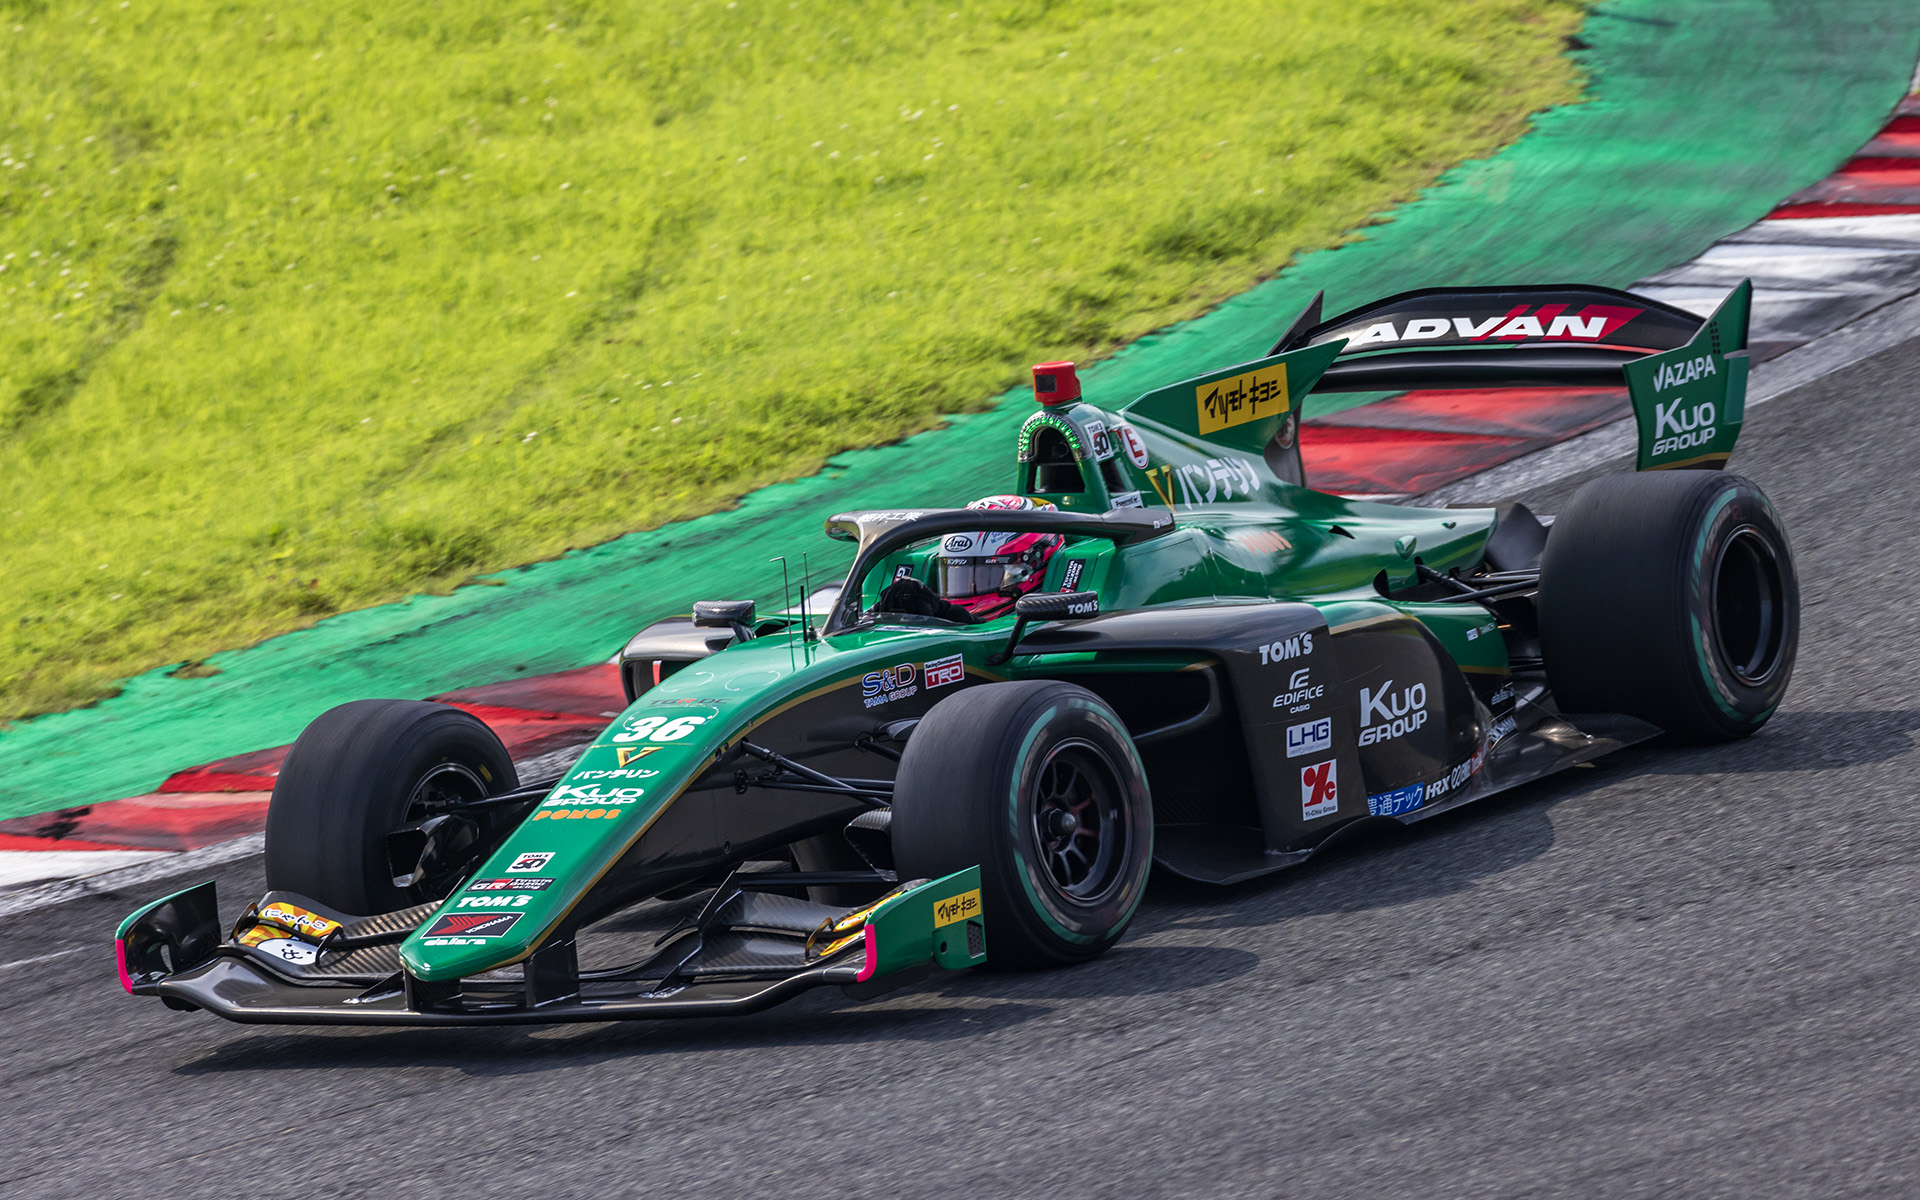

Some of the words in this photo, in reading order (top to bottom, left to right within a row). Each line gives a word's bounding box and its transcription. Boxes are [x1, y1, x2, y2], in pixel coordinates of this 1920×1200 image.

[1351, 315, 1608, 347] ADVAN
[1123, 428, 1144, 458] E
[1651, 427, 1716, 457] GROUP
[1176, 457, 1260, 510] バンテリン
[1068, 600, 1098, 615] TOM'S
[1259, 632, 1313, 665] TOM'S
[861, 662, 916, 697] S&D
[927, 664, 961, 684] TRD
[888, 685, 918, 701] GROUP
[1273, 684, 1324, 708] EDIFICE
[1289, 703, 1310, 714] CASIO
[612, 716, 708, 742] 36
[1289, 721, 1329, 748] LHG
[1358, 709, 1428, 747] GROUP
[572, 768, 660, 780] バンテリン
[542, 797, 637, 807] GROUP
[532, 809, 622, 821] PONOS
[468, 880, 508, 890] GR
[456, 895, 534, 908] TOM'S
[465, 915, 513, 934] YOKOHAMA
